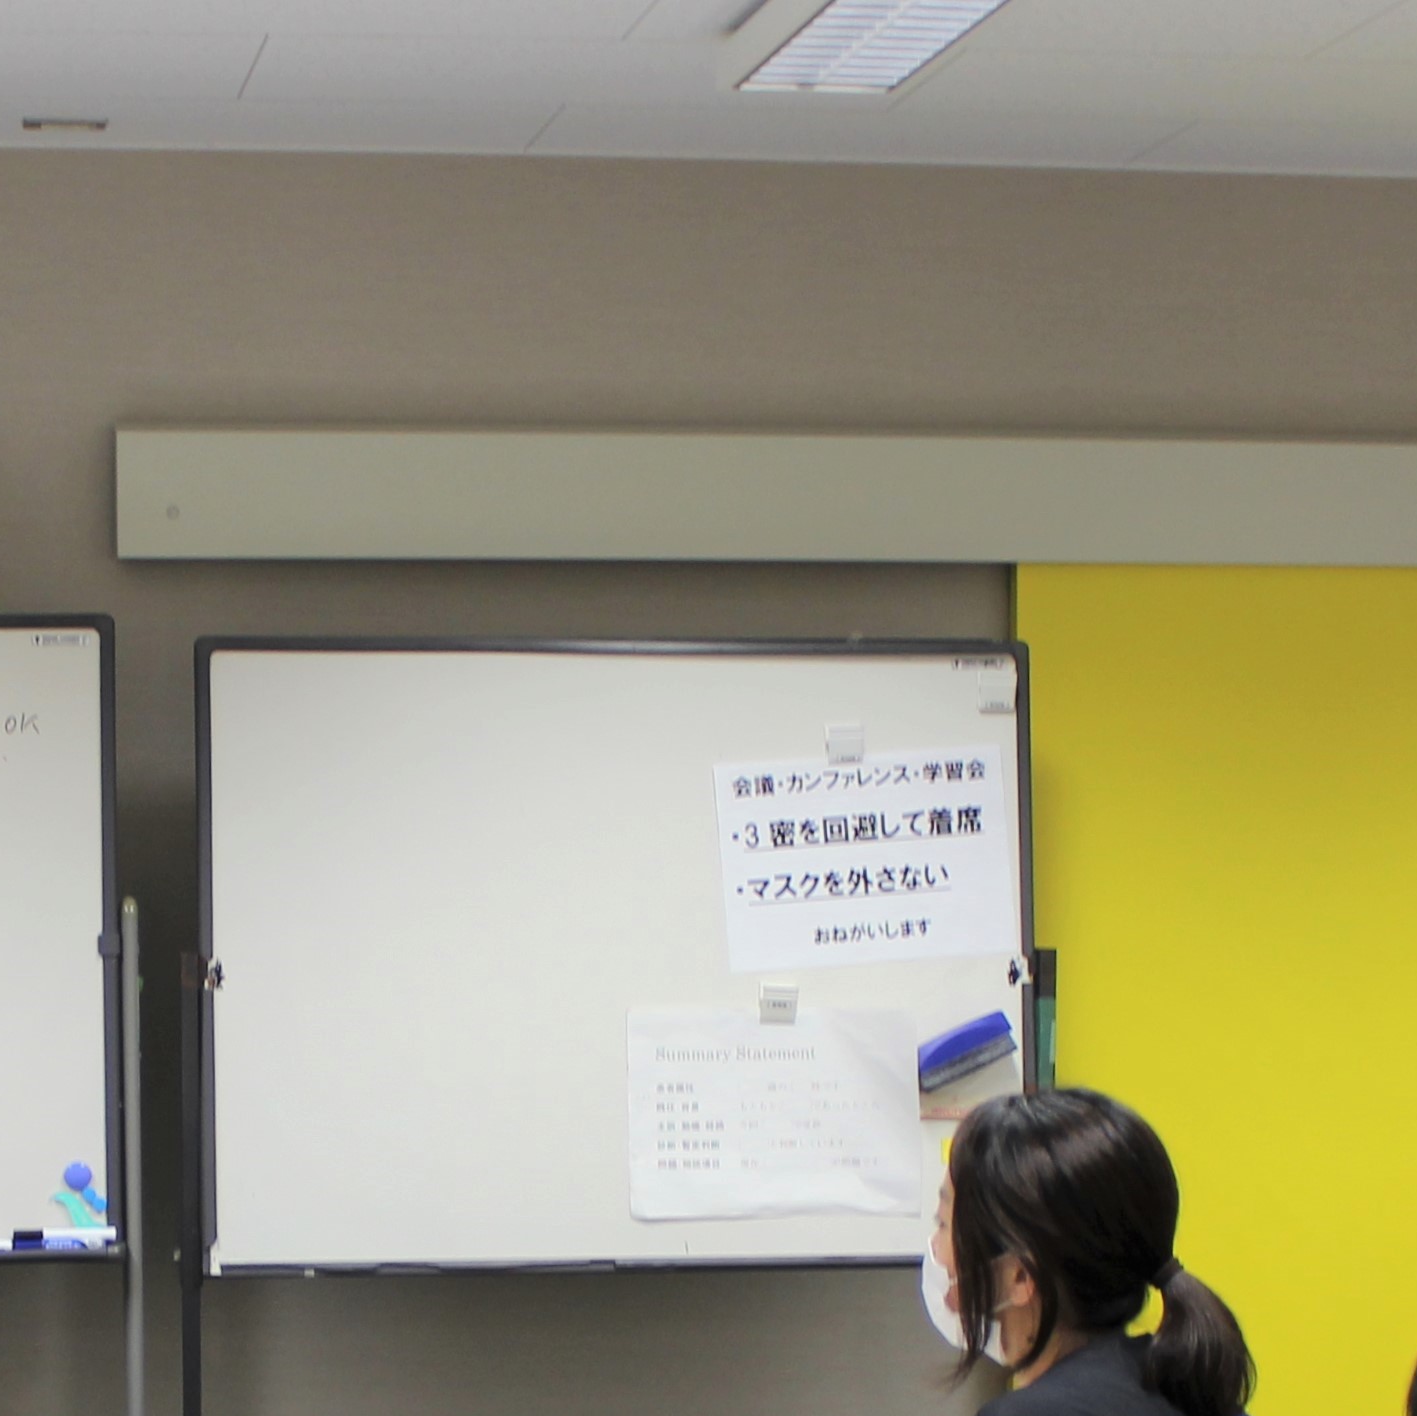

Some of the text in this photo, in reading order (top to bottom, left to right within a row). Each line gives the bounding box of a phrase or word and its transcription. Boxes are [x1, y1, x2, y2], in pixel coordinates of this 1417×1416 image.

[733, 758, 986, 800] 会議・カンファレンス・学習会
[814, 917, 932, 946] おねがいします
[655, 1044, 817, 1065] Summary Statement
